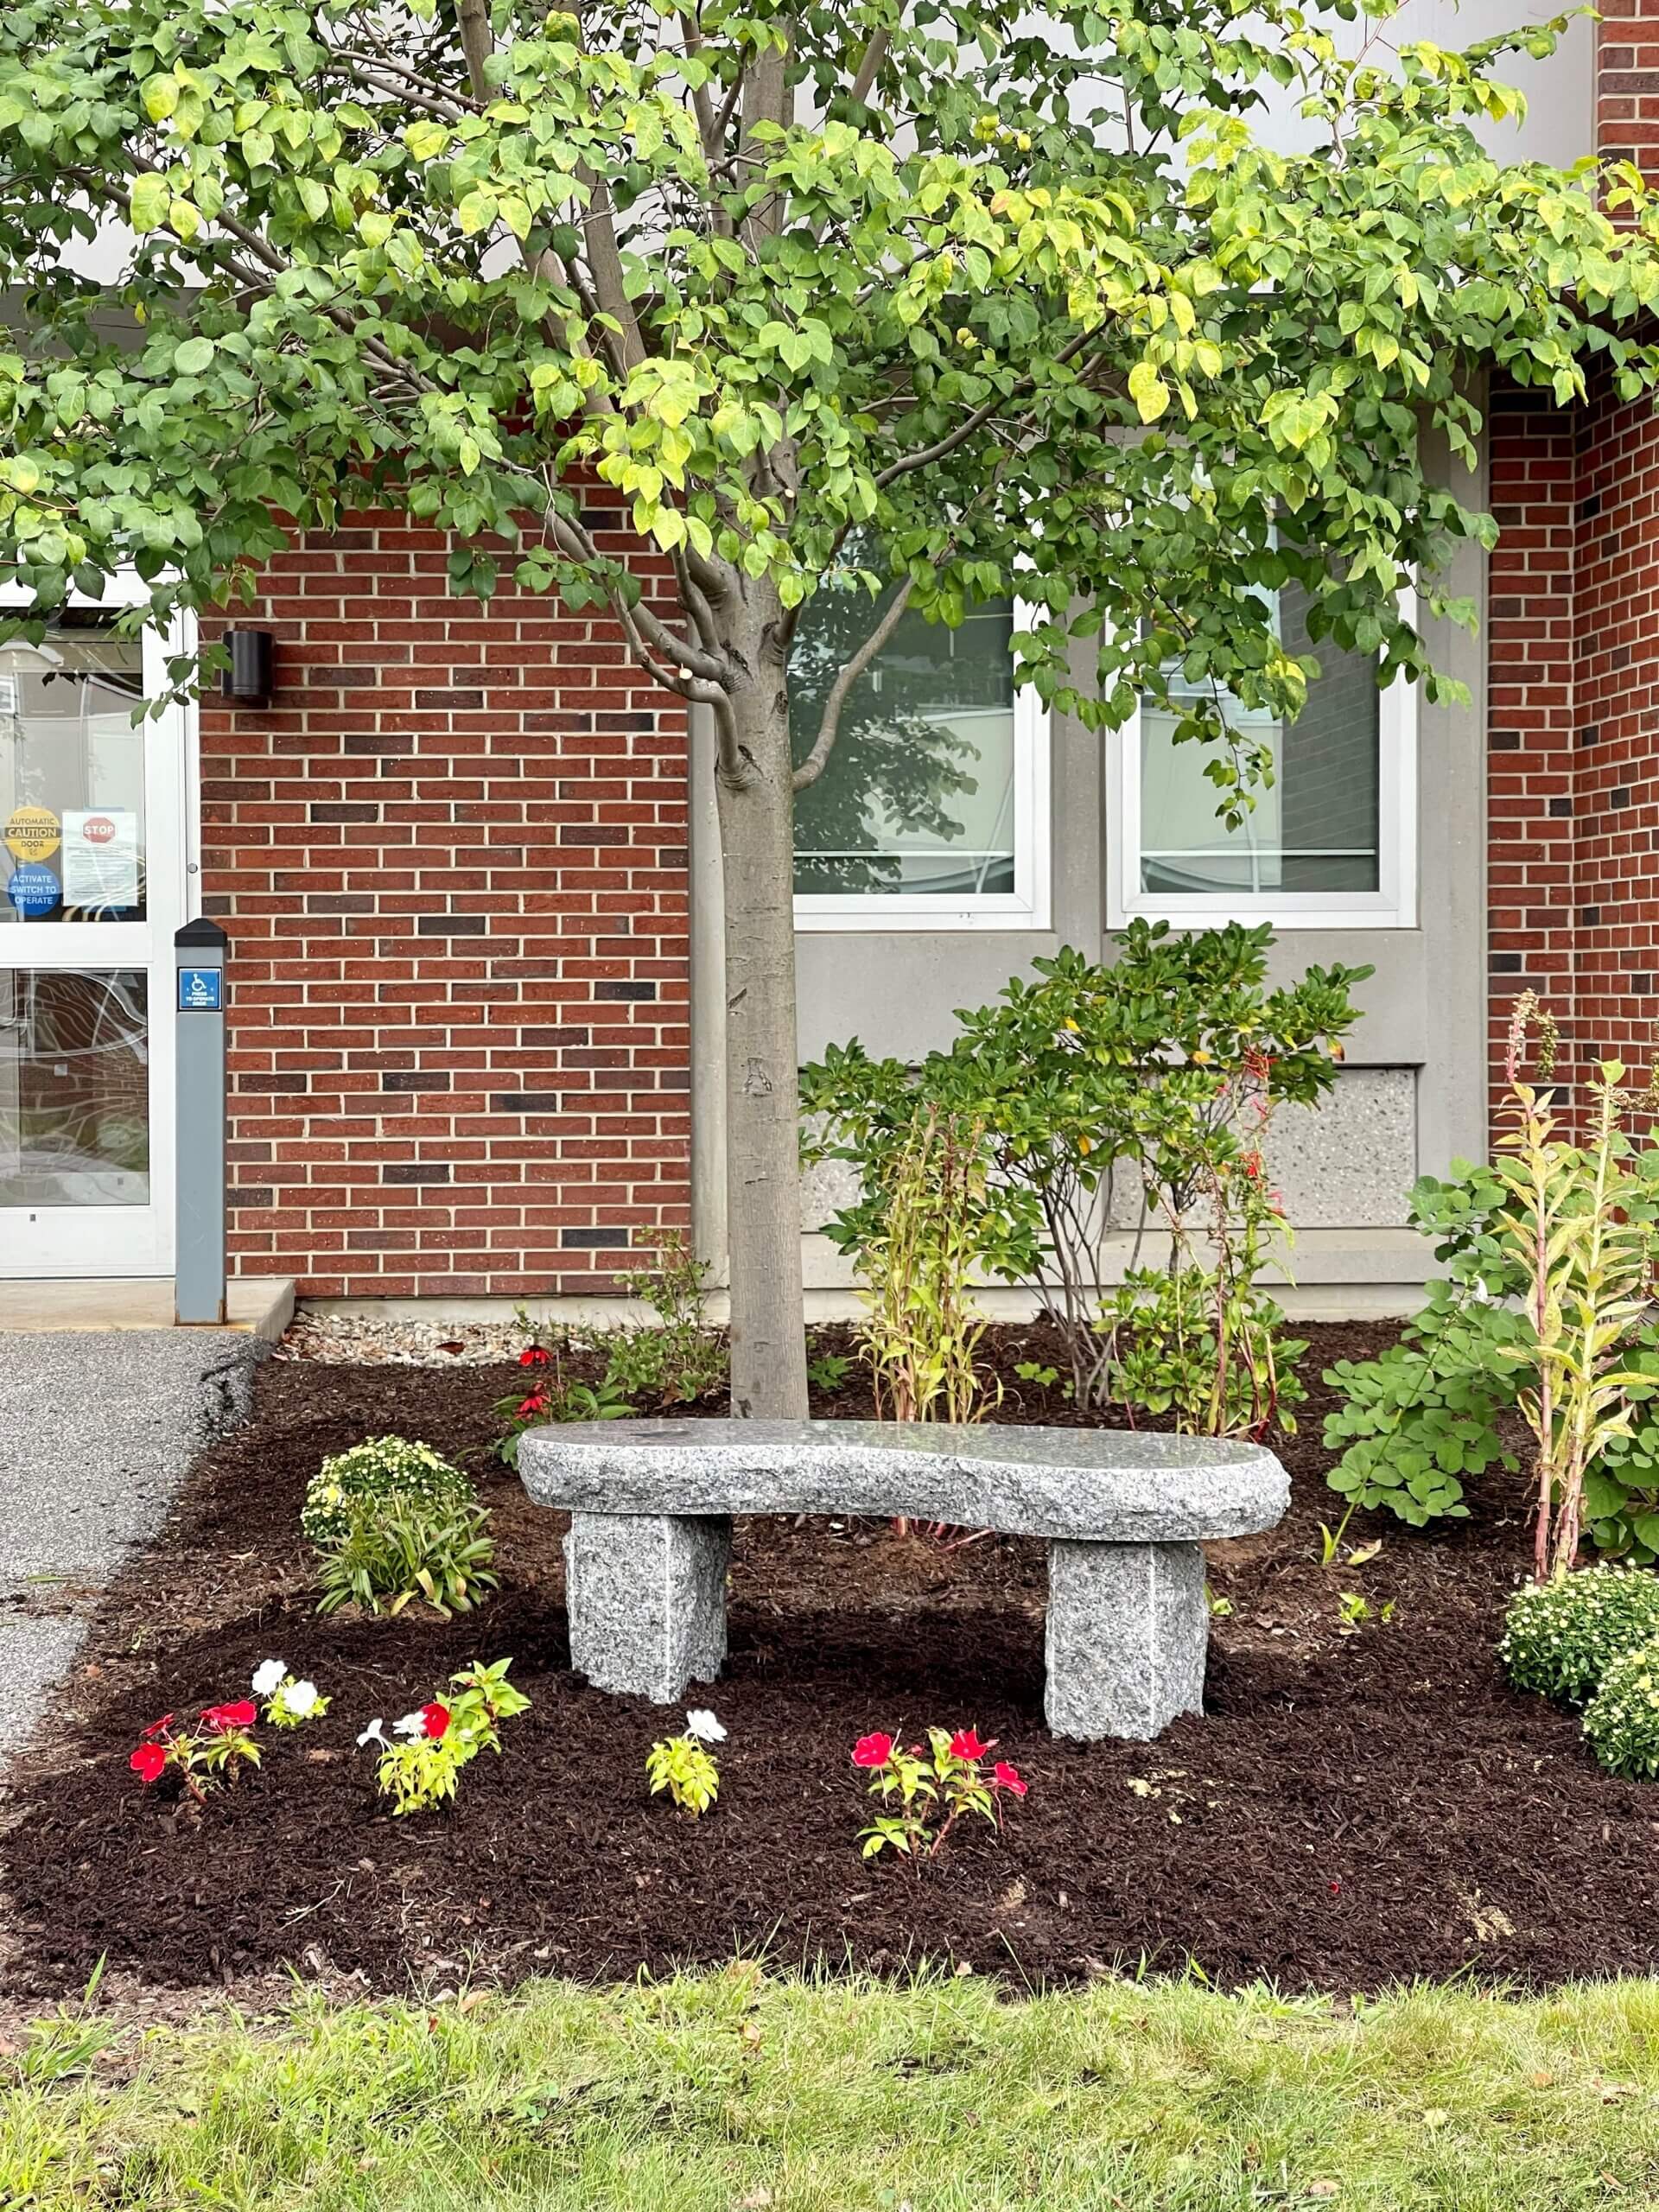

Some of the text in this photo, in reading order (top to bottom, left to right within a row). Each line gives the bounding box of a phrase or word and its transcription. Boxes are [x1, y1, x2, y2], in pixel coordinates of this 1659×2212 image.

[8, 828, 57, 837] CAUTION
[84, 825, 114, 835] STOP
[11, 886, 43, 894] SWITCH
[15, 896, 53, 905] OPERATE
